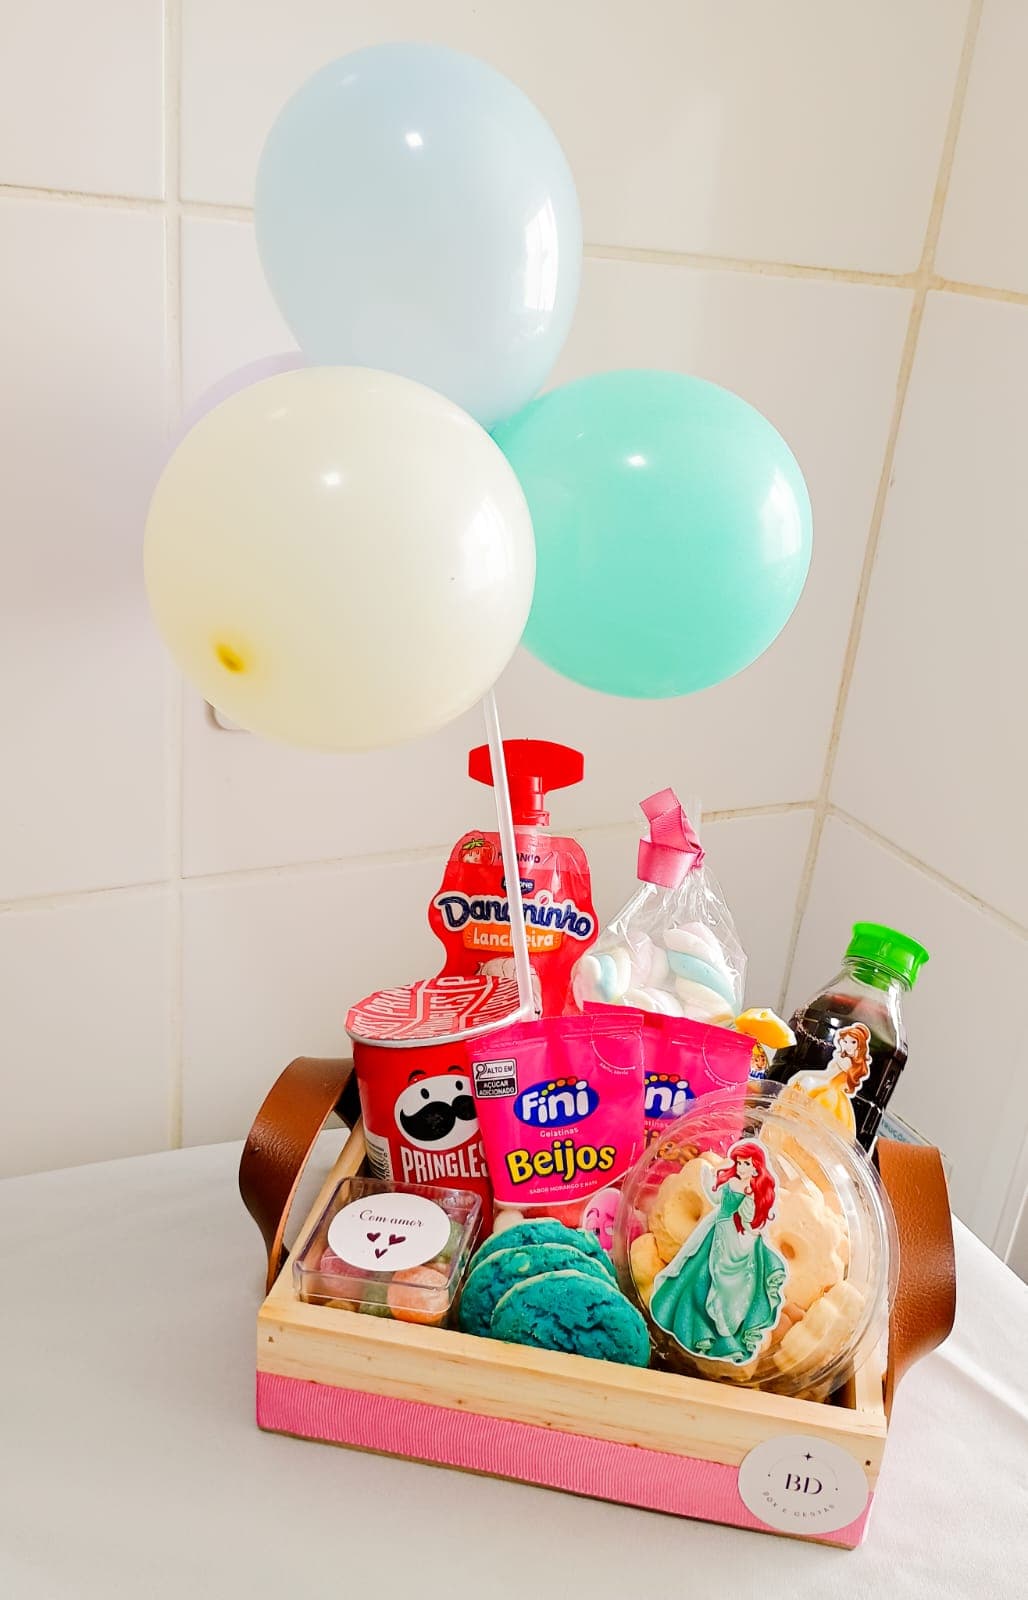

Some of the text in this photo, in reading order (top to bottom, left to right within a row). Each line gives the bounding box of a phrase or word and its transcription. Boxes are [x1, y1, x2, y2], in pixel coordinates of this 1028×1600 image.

[473, 927, 554, 948] Lanceira
[487, 1066, 503, 1074] ALTO
[522, 1081, 589, 1123] Fini
[645, 1081, 688, 1115] ni
[540, 1127, 579, 1138] Gelatinas
[506, 1139, 616, 1184] Beijos
[359, 1209, 424, 1227] Com amor
[785, 1473, 823, 1495] BD
